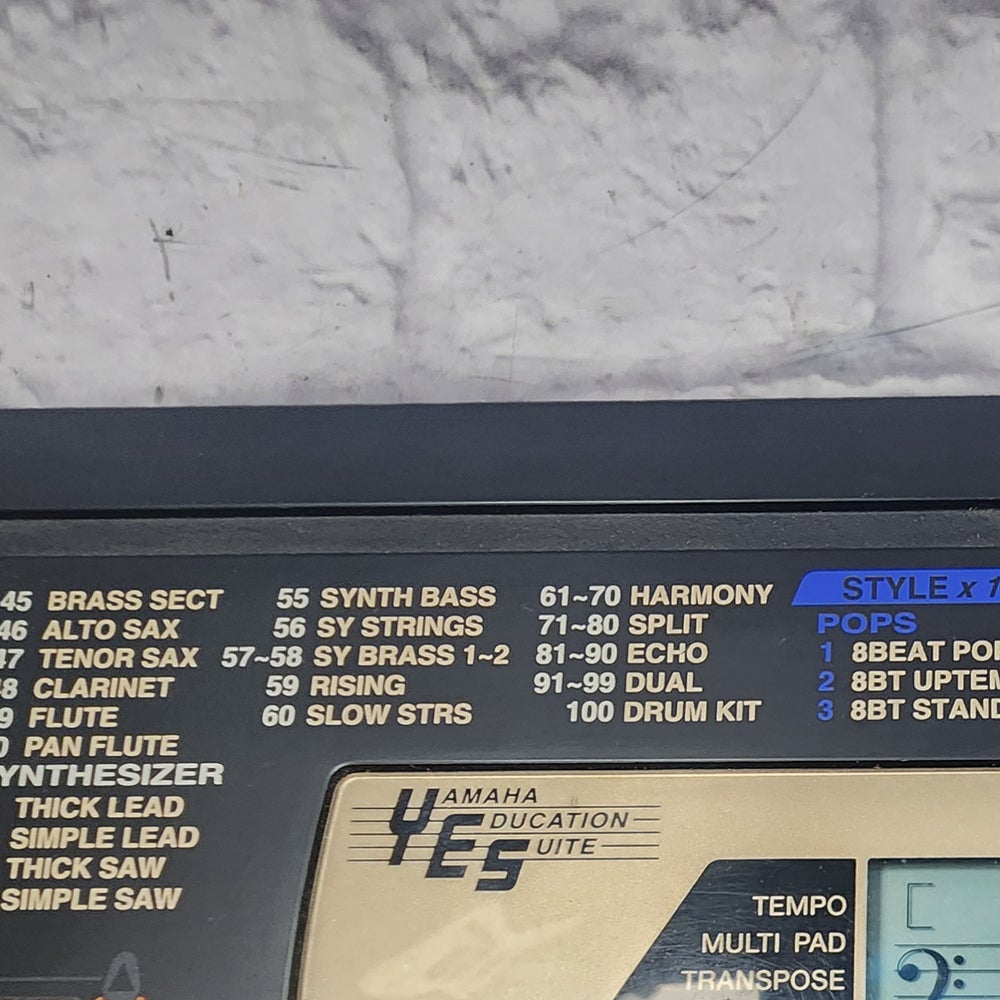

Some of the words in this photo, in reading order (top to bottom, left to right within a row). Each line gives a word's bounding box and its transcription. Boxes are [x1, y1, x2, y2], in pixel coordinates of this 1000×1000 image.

[277, 588, 309, 608] 55
[320, 587, 413, 608] SYNTH
[421, 586, 496, 607] BASS
[631, 584, 773, 605] HARMONY
[843, 576, 948, 600] STYLE
[957, 582, 977, 598] x
[0, 591, 33, 611] 45
[48, 590, 142, 611] BRASS
[150, 589, 224, 610] SECT
[42, 619, 116, 640] ALTO
[123, 619, 180, 639] SAX
[273, 617, 306, 638] 56
[317, 617, 355, 637] SY
[361, 615, 483, 637] STRINGS
[629, 614, 708, 634] SPLIT
[817, 612, 917, 635] POPS
[39, 648, 135, 668] TENOR
[141, 647, 199, 668] SAX
[314, 646, 352, 666] SY
[358, 644, 454, 665] BRASS
[628, 642, 708, 663] ECHO
[852, 641, 945, 662] 8BEAT
[34, 677, 175, 699] CLARINET
[266, 675, 299, 696] 59
[310, 675, 405, 696] RISING
[626, 672, 702, 692] DUAL
[852, 671, 906, 691] 8BT
[29, 707, 119, 728] FLUTE
[262, 705, 295, 726] 60
[306, 704, 391, 725] SLOW
[397, 703, 472, 725] STRS
[567, 701, 614, 722] 100
[624, 701, 707, 722] DRUM
[717, 701, 762, 721] KIT
[851, 699, 905, 720] 8BT
[24, 736, 82, 757] PAN
[89, 735, 179, 756] FLUTE
[15, 797, 101, 818] THICK
[107, 796, 184, 817] LEAD
[10, 827, 115, 849] SIMPLE
[122, 827, 199, 848] LEAD
[6, 857, 93, 879] THICK
[99, 857, 166, 879] SAW
[0, 888, 108, 911] SIMPLE
[114, 887, 182, 910] SAW
[752, 895, 846, 916] TEMPO
[702, 933, 779, 953] MULTI
[795, 933, 846, 952] PAD
[681, 970, 845, 991] TRANSPOSE
